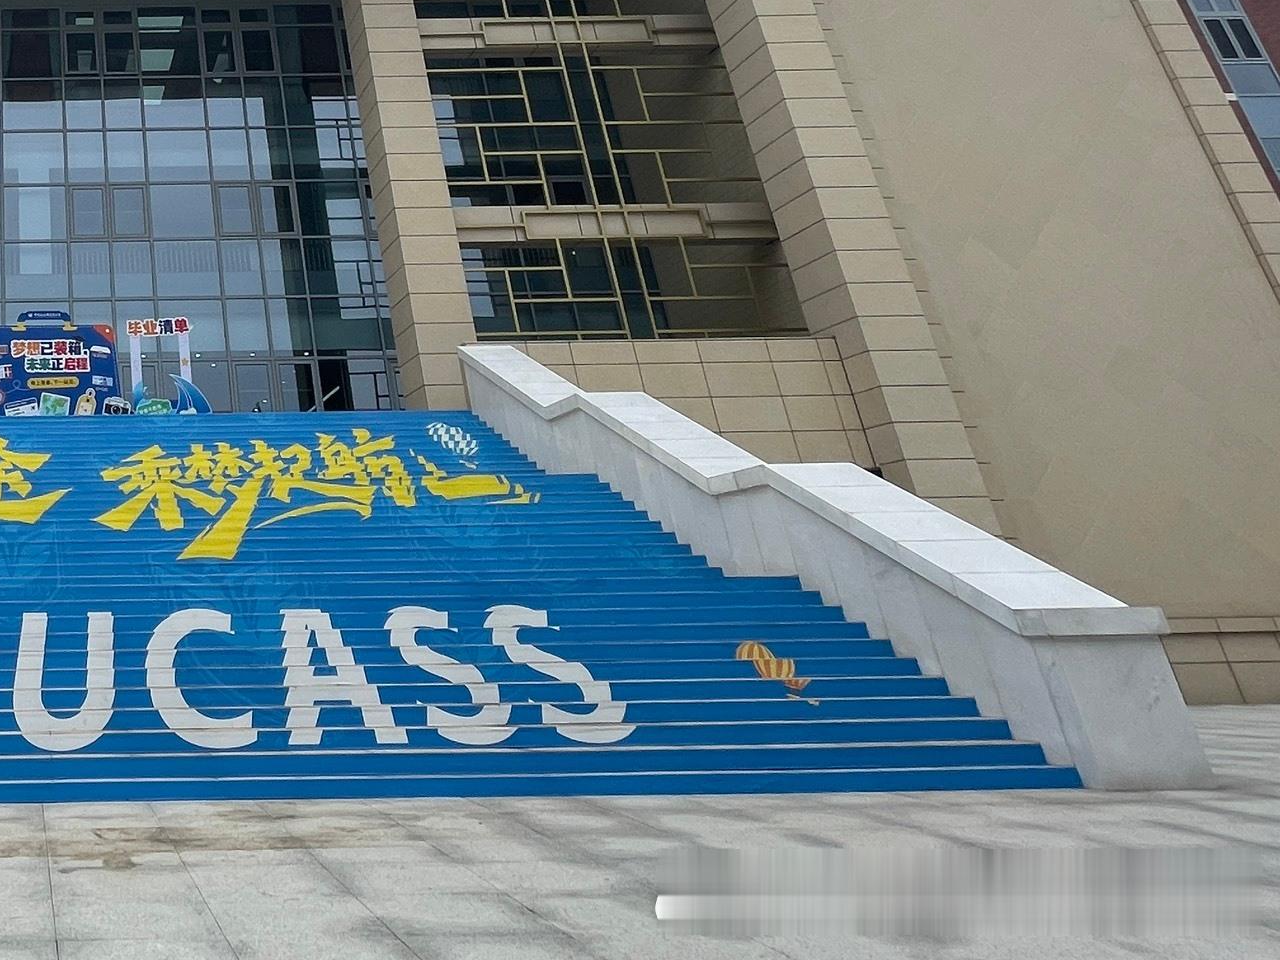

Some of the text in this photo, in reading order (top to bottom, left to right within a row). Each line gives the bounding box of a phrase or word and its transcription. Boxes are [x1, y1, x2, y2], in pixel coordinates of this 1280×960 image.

[26, 357, 89, 371] 未来正启程
[127, 318, 189, 336] 毕业清单
[94, 428, 540, 559] 乘梦起航
[12, 605, 637, 752] UCASS
